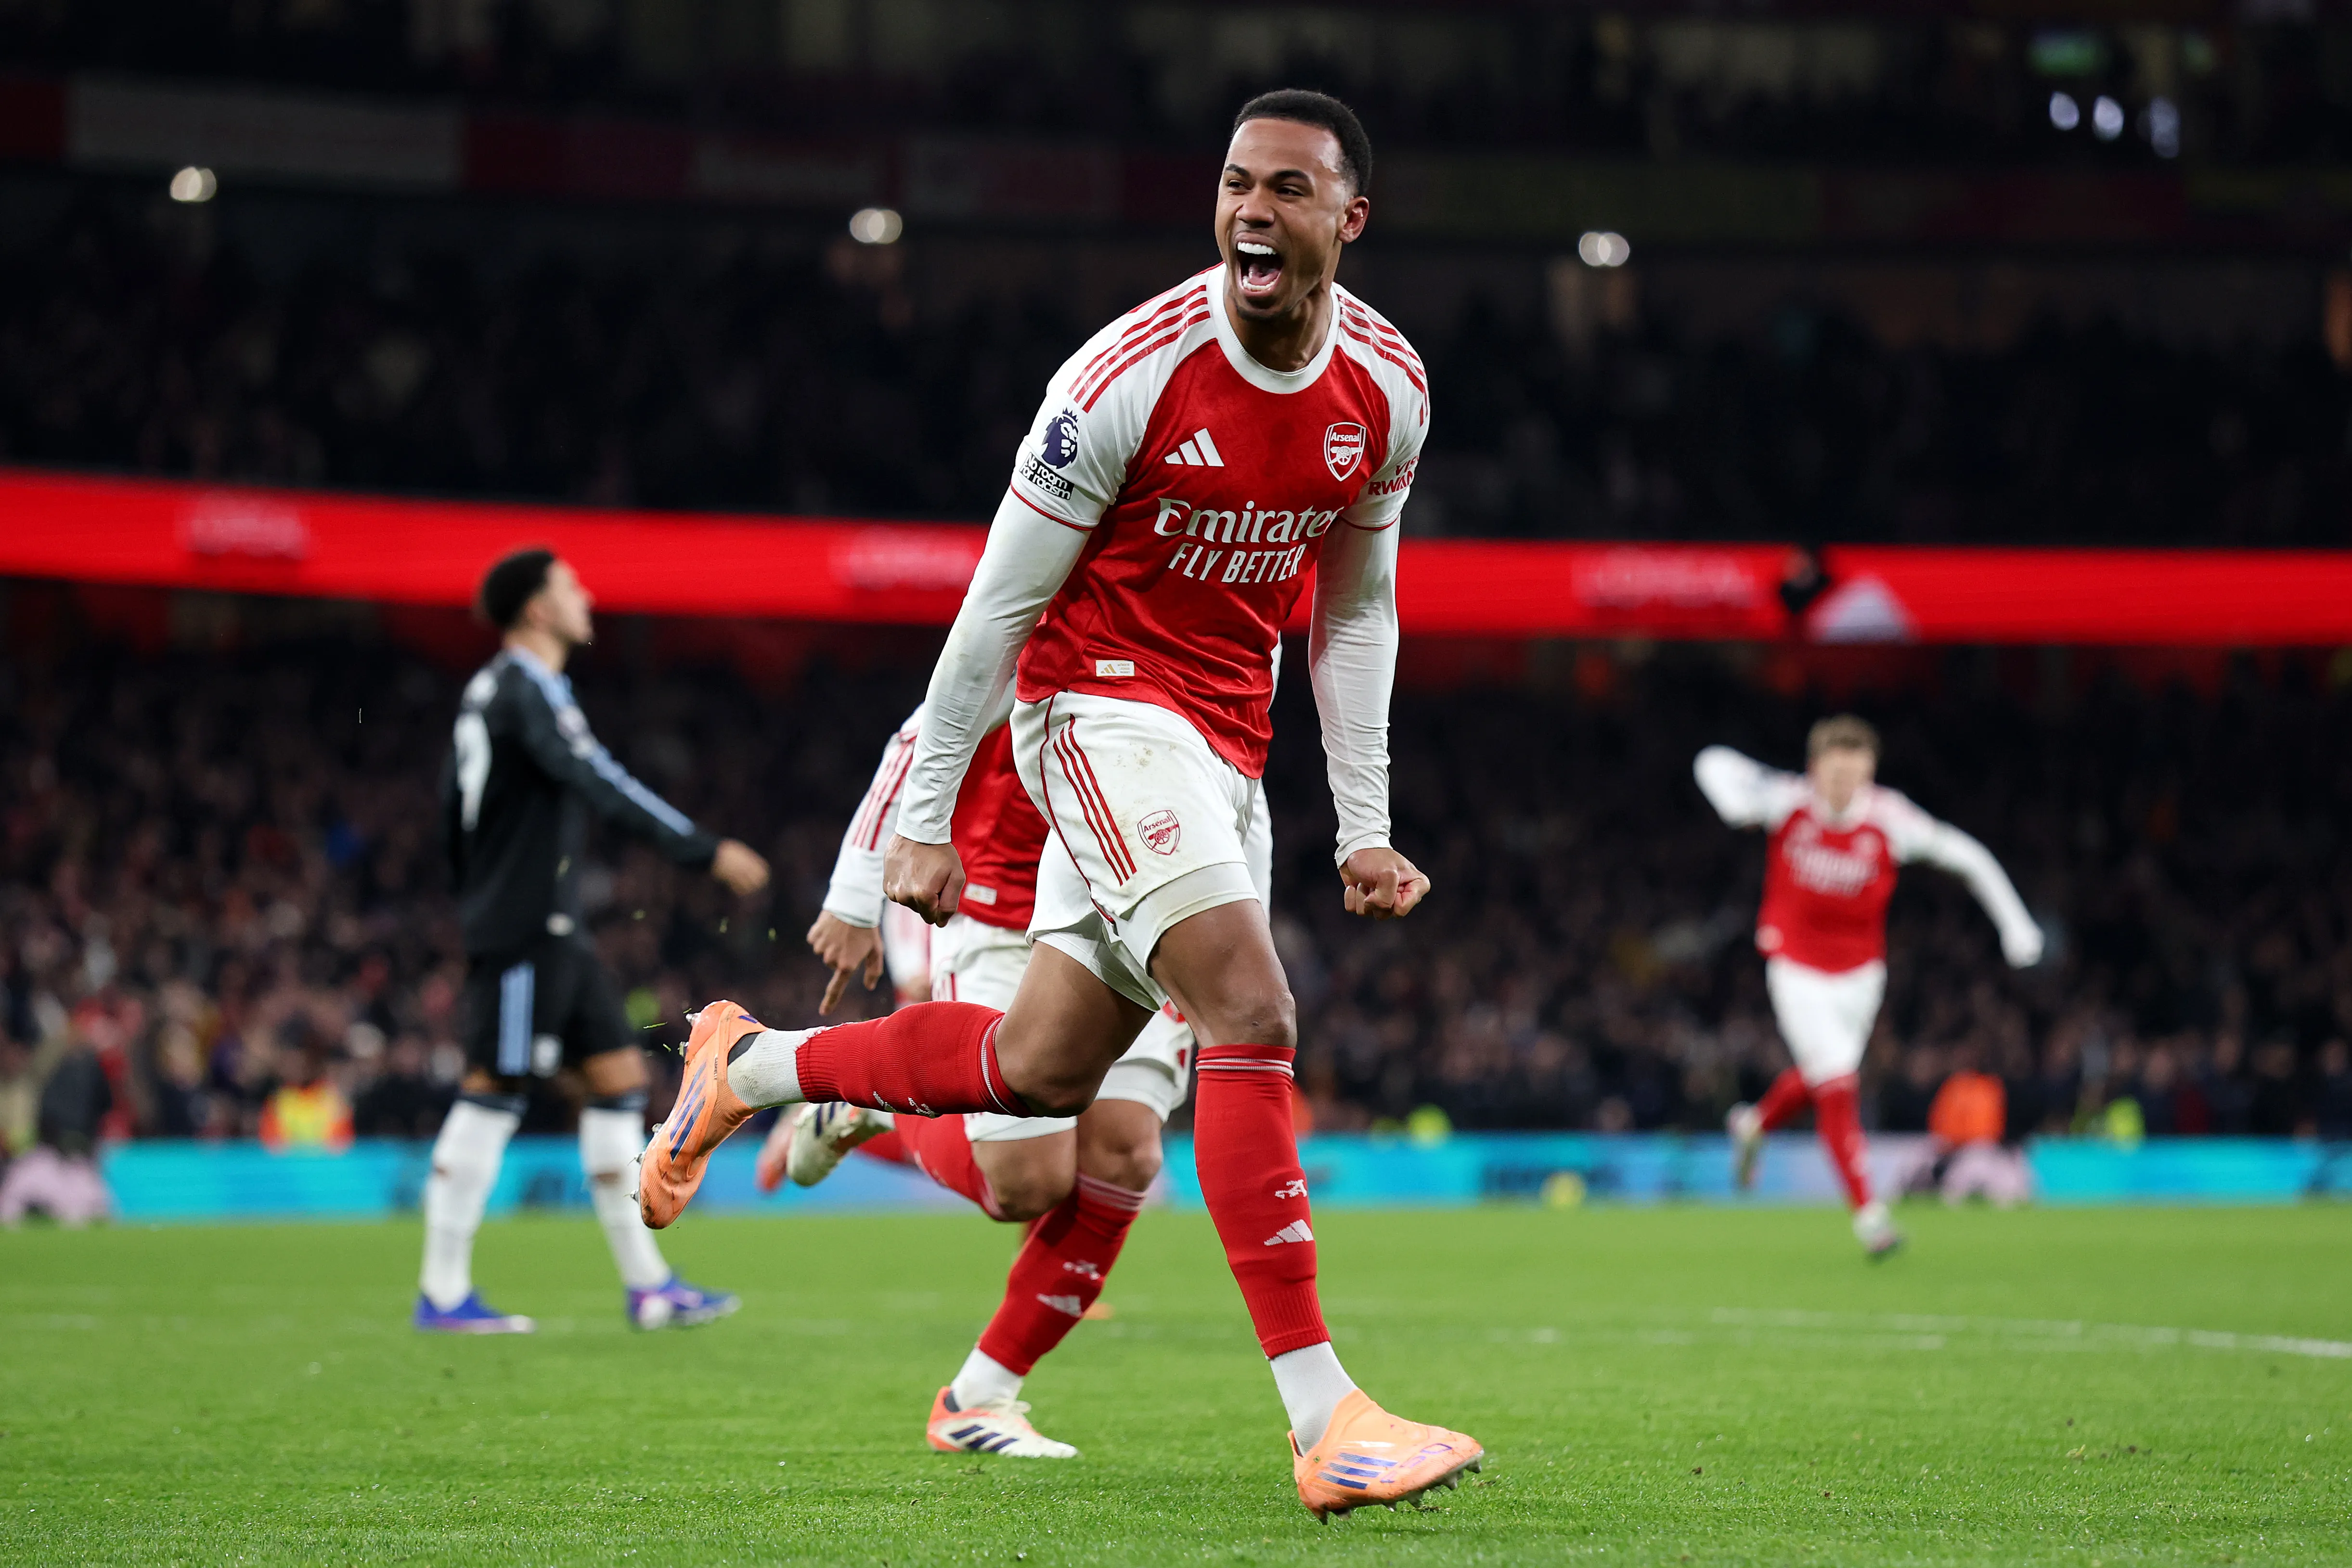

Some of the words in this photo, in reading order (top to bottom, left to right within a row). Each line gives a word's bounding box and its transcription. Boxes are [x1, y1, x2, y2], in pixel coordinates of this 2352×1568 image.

[1331, 432, 1360, 442] Arsenal
[1025, 452, 1038, 470] No
[1037, 465, 1068, 489] room
[1032, 474, 1071, 500] racism
[1168, 543, 1223, 581] FLY
[1221, 543, 1307, 583] BETTER
[1144, 816, 1171, 833] Arsenal
